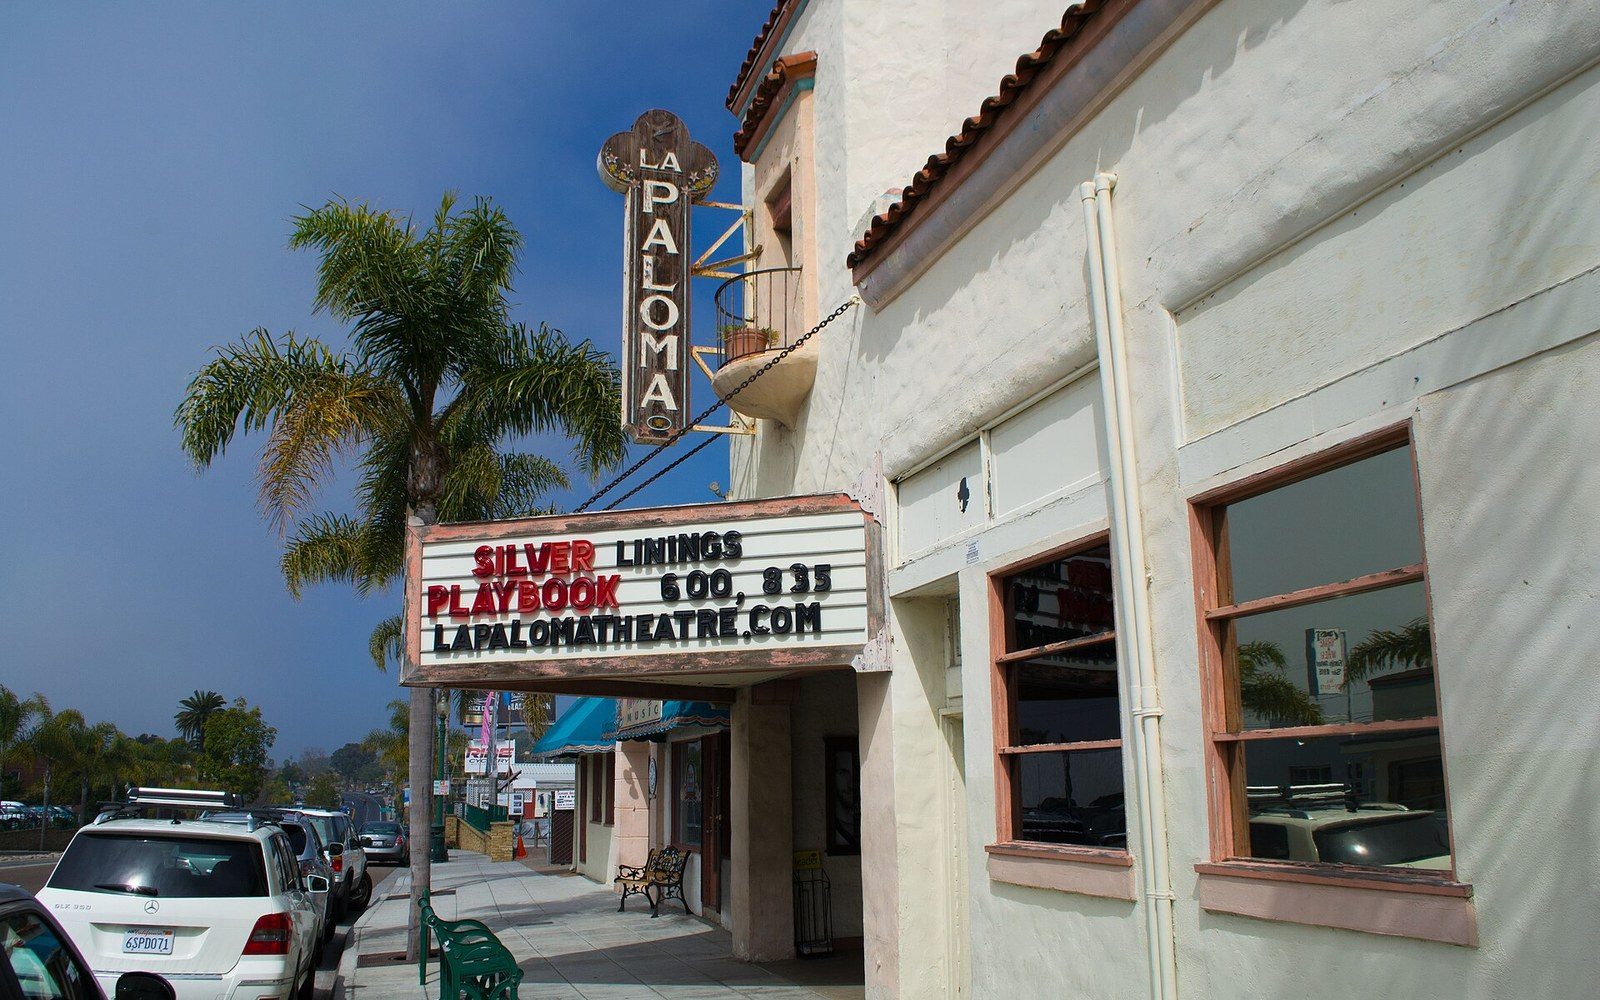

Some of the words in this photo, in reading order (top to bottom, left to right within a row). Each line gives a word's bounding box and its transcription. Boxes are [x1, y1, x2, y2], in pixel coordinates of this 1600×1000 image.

[640, 148, 682, 173] LA
[640, 179, 680, 411] PALOMA
[473, 540, 595, 578] SILVER
[616, 530, 743, 567] LININGS
[428, 574, 621, 618] PLAYBOOK
[660, 568, 746, 606] 600,
[763, 563, 831, 594] 835
[434, 602, 821, 652] LAPALOMATHEATRE.COM
[627, 705, 659, 721] MUSIC
[126, 937, 169, 950] 6SPD071
